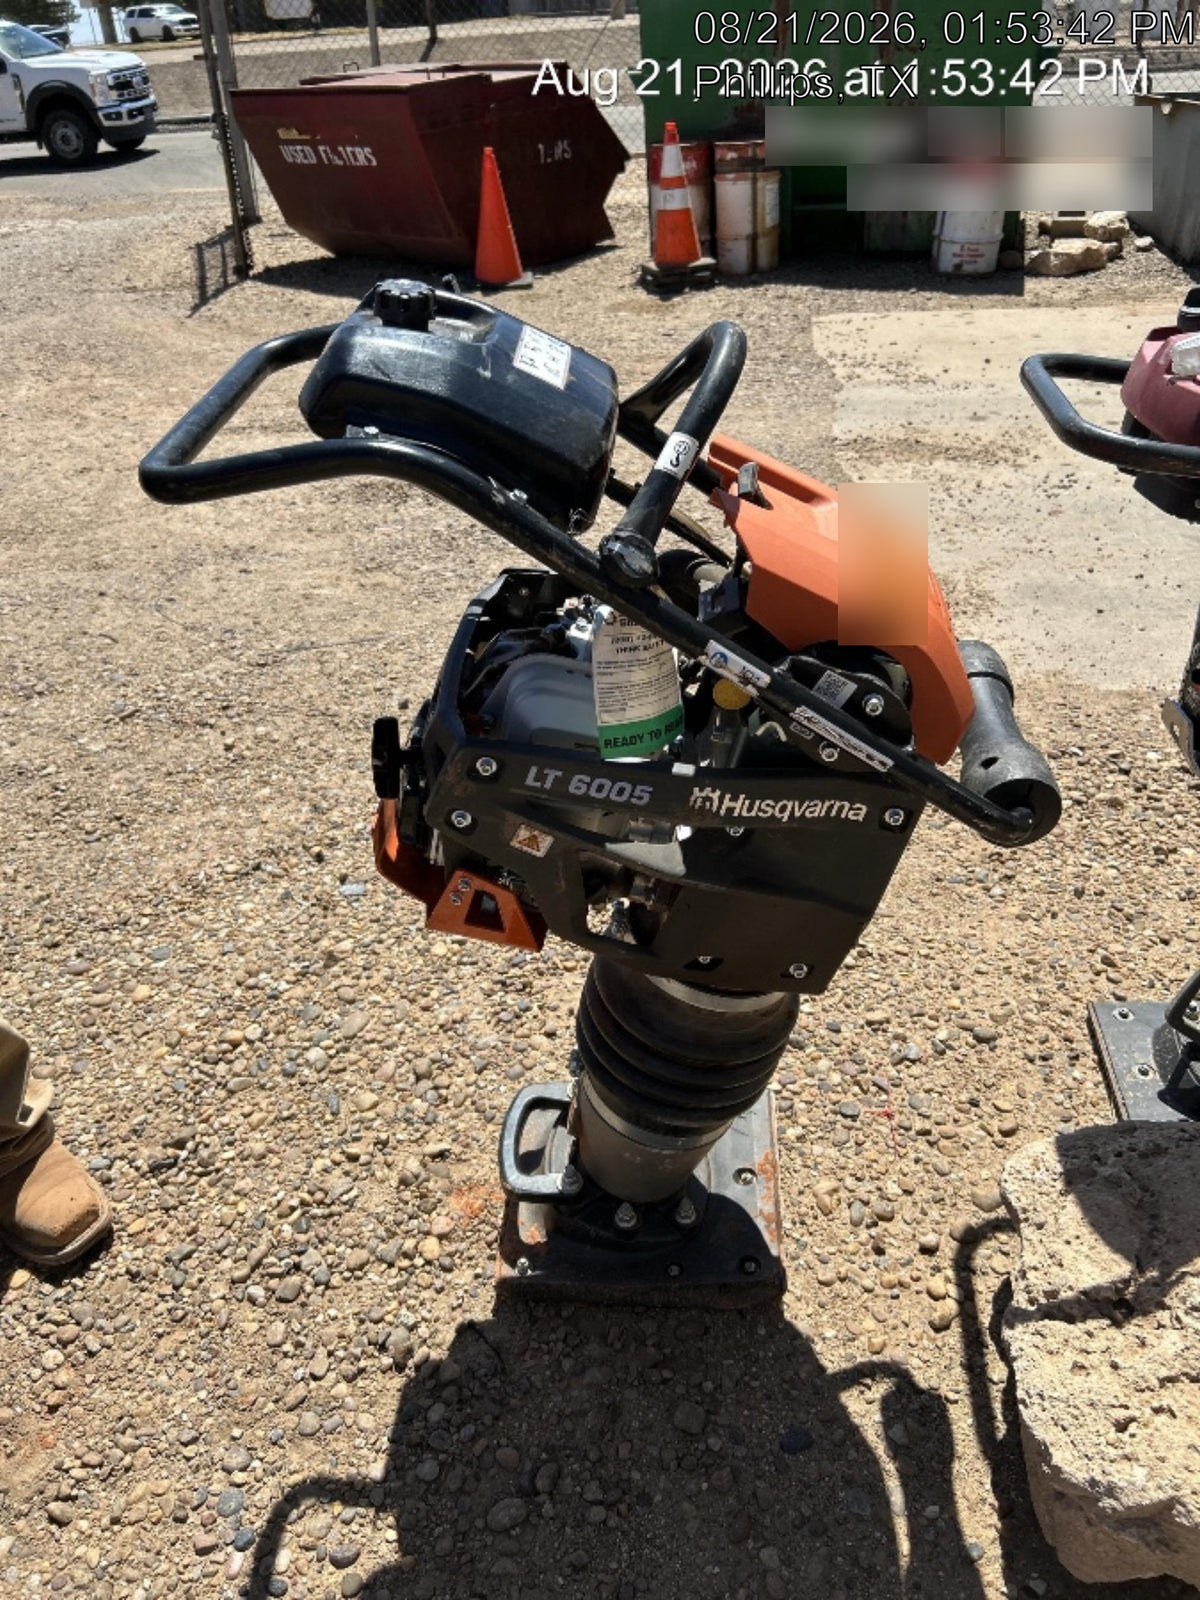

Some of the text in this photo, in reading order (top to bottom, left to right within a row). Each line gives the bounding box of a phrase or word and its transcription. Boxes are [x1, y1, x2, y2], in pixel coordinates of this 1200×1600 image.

[278, 144, 318, 165] USED
[604, 733, 645, 749] READY
[646, 728, 662, 742] TO
[524, 765, 654, 806] LT 6005
[719, 793, 868, 823] Husqvarna
